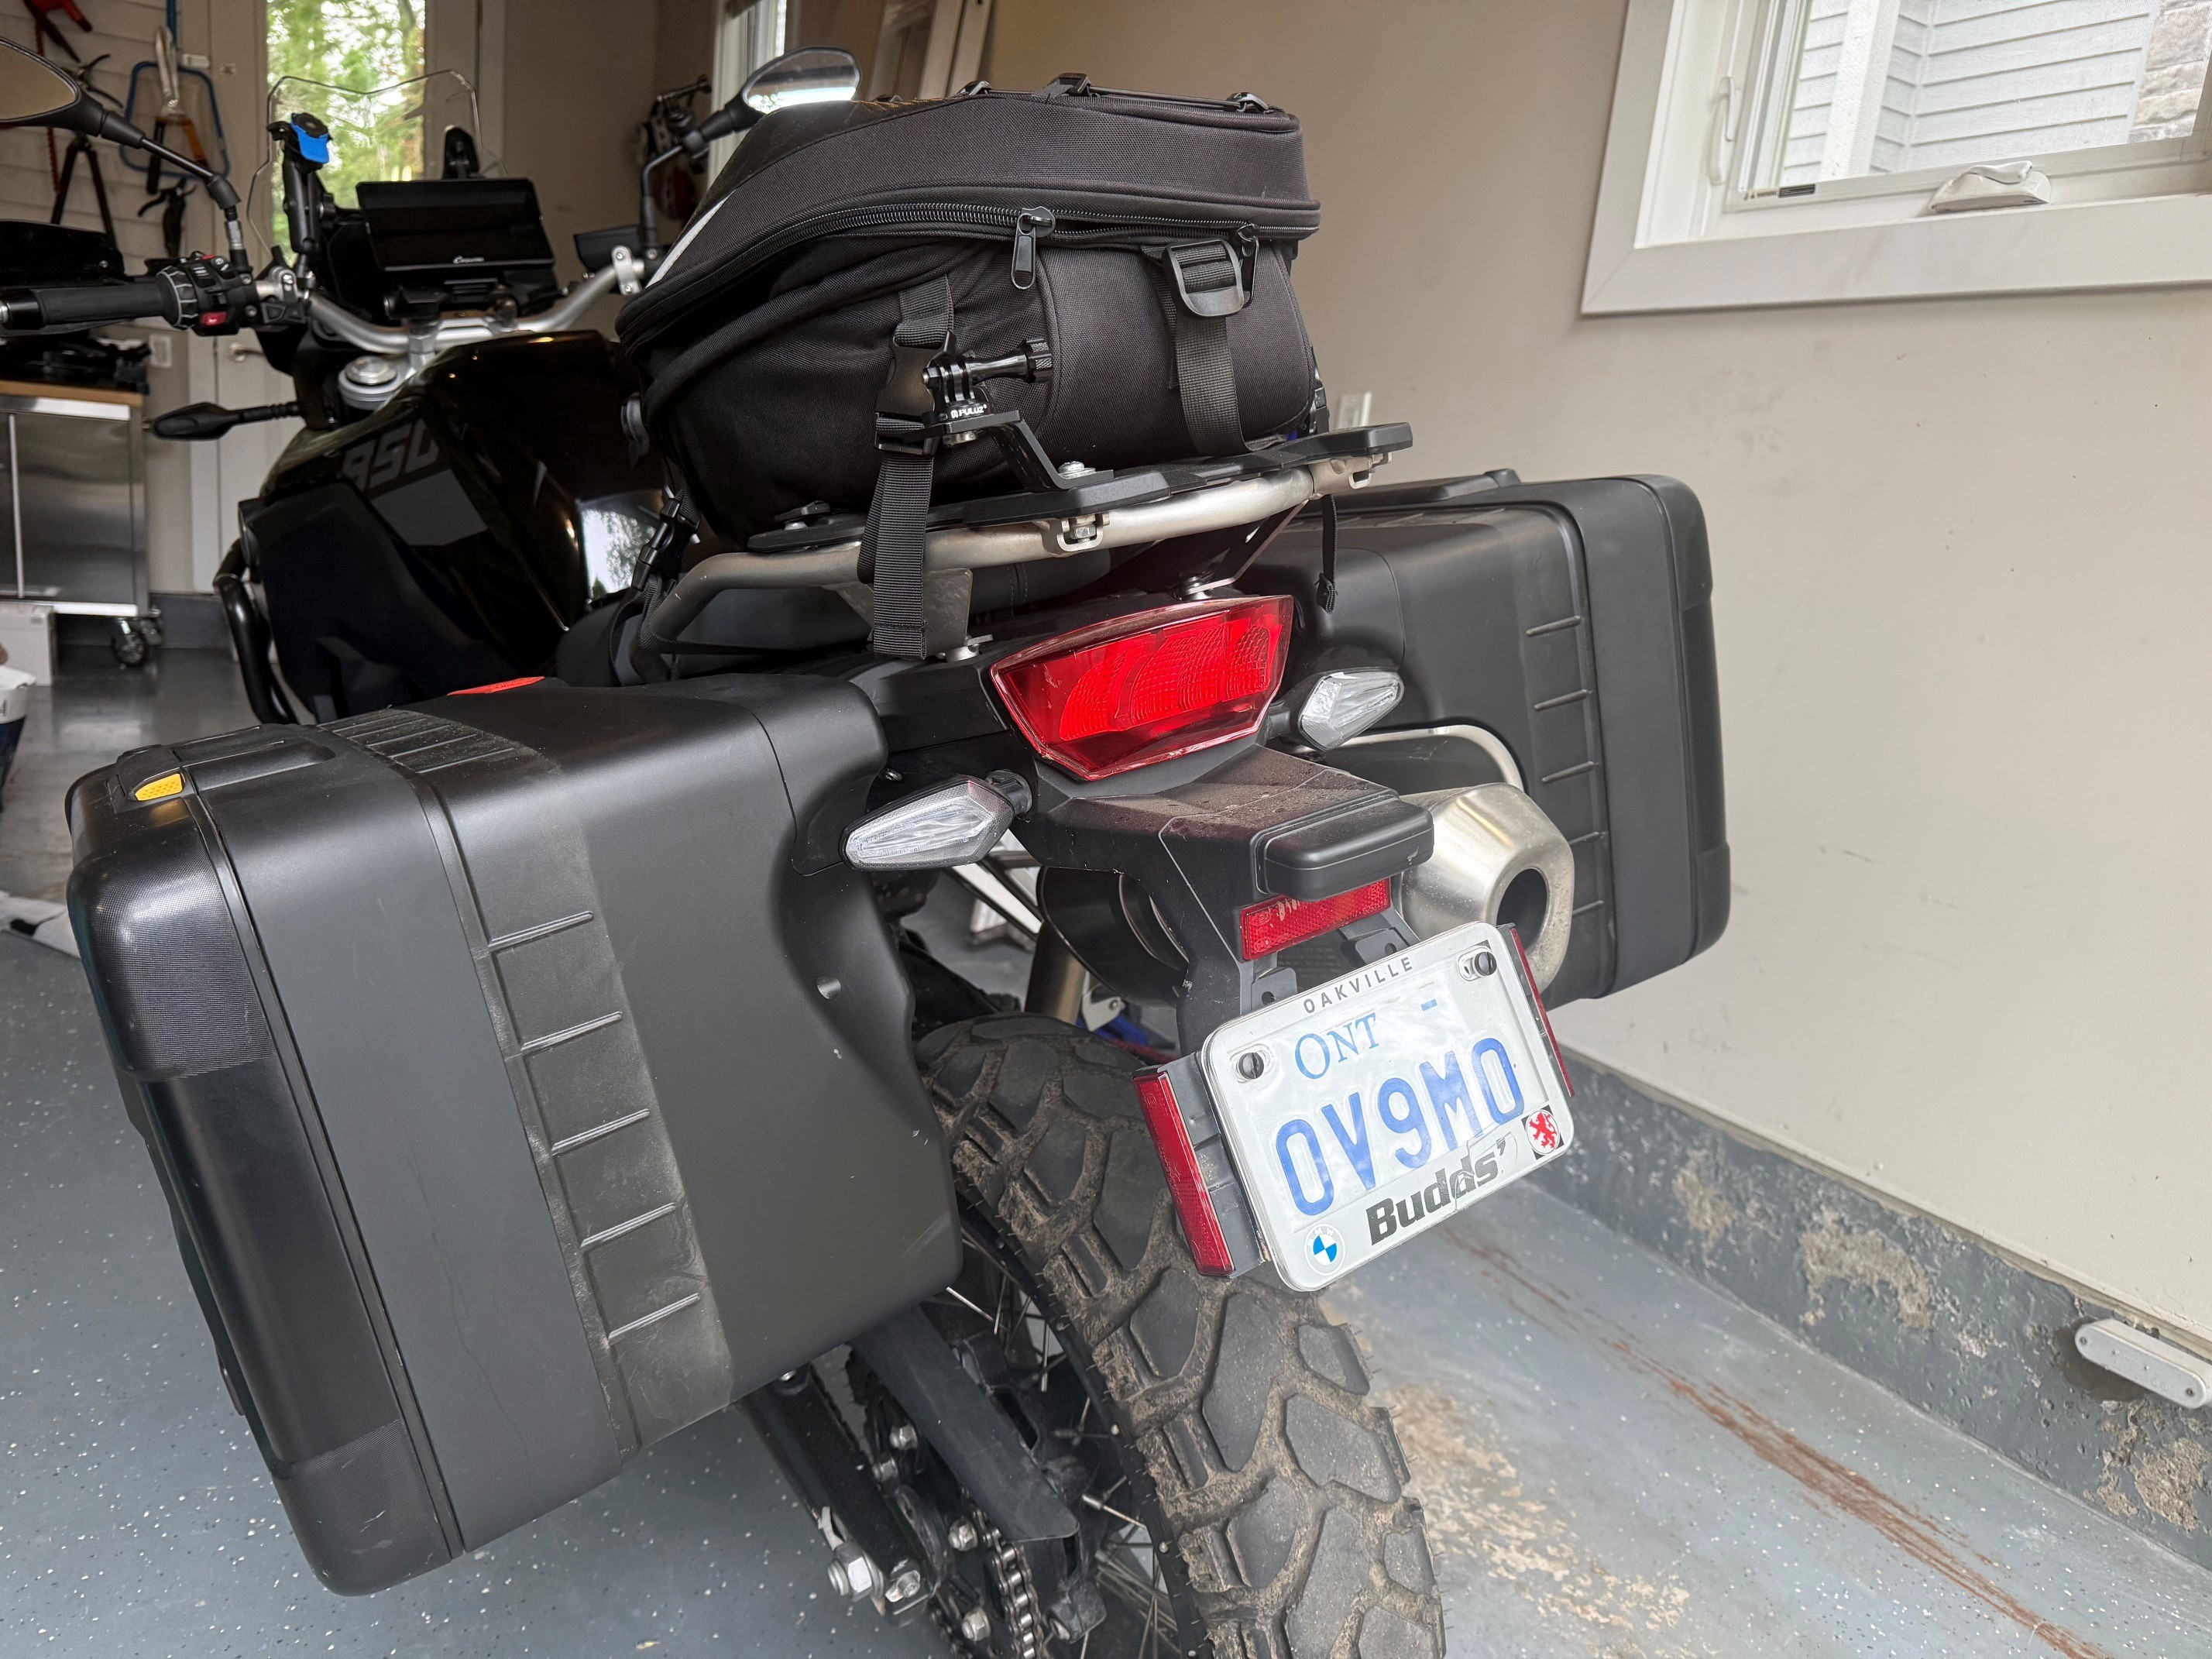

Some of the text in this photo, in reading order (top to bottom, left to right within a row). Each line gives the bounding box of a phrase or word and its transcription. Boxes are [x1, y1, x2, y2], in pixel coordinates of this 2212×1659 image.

[958, 406, 984, 417] PULUZ
[1304, 957, 1413, 1014] OAKVILLE
[1294, 1012, 1379, 1080] ONT
[1365, 1136, 1506, 1246] Budds'
[1307, 1227, 1334, 1248] BMW
